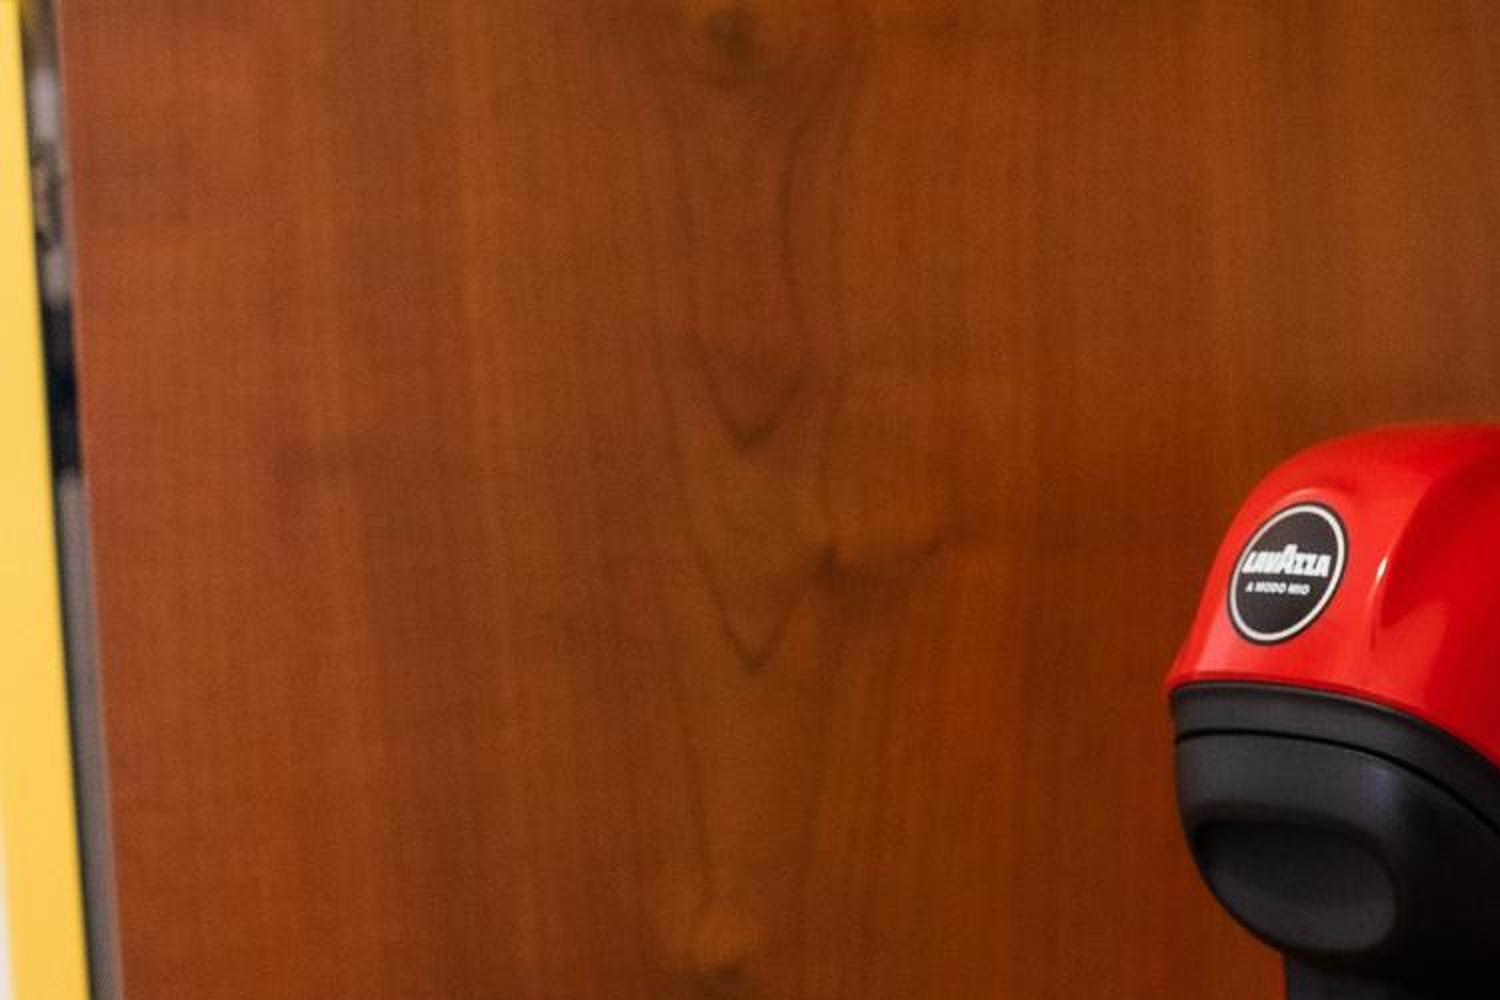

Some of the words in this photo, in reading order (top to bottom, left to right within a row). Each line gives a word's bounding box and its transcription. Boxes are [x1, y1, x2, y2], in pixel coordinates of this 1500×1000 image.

[1242, 543, 1331, 578] LAVAZZA
[1245, 582, 1254, 592] A
[1255, 582, 1287, 594] MODO
[1288, 583, 1311, 595] MIO
